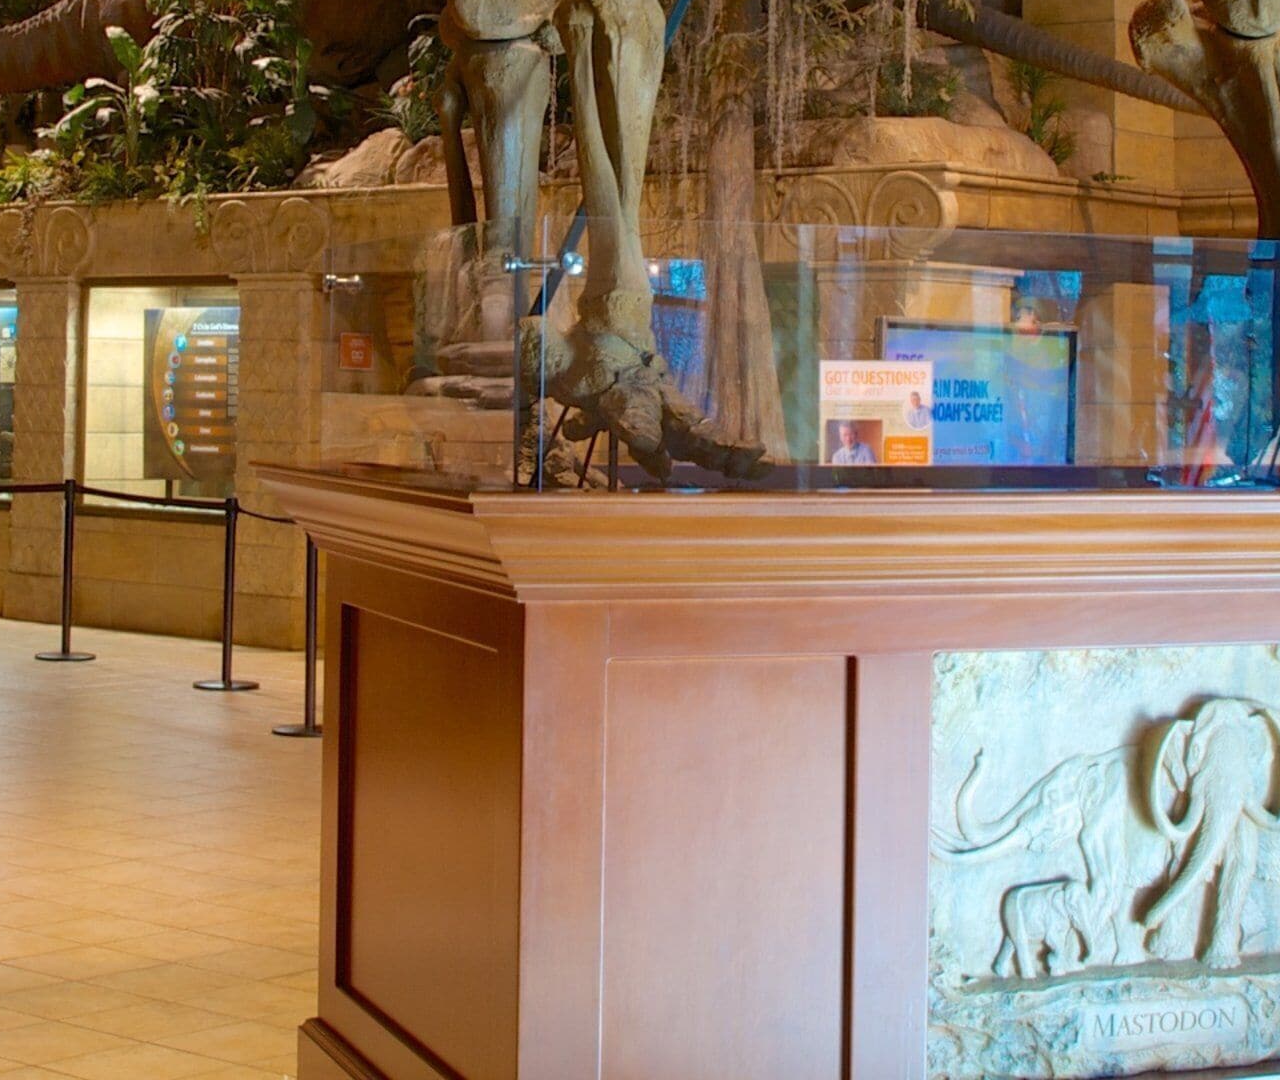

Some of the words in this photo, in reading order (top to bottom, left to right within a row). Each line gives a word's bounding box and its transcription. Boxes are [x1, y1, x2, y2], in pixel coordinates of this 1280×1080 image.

[825, 370, 849, 385] GOT
[851, 370, 927, 386] QUESTIONS?
[953, 379, 990, 399] DRINK
[1093, 1006, 1236, 1039] MASTODON
